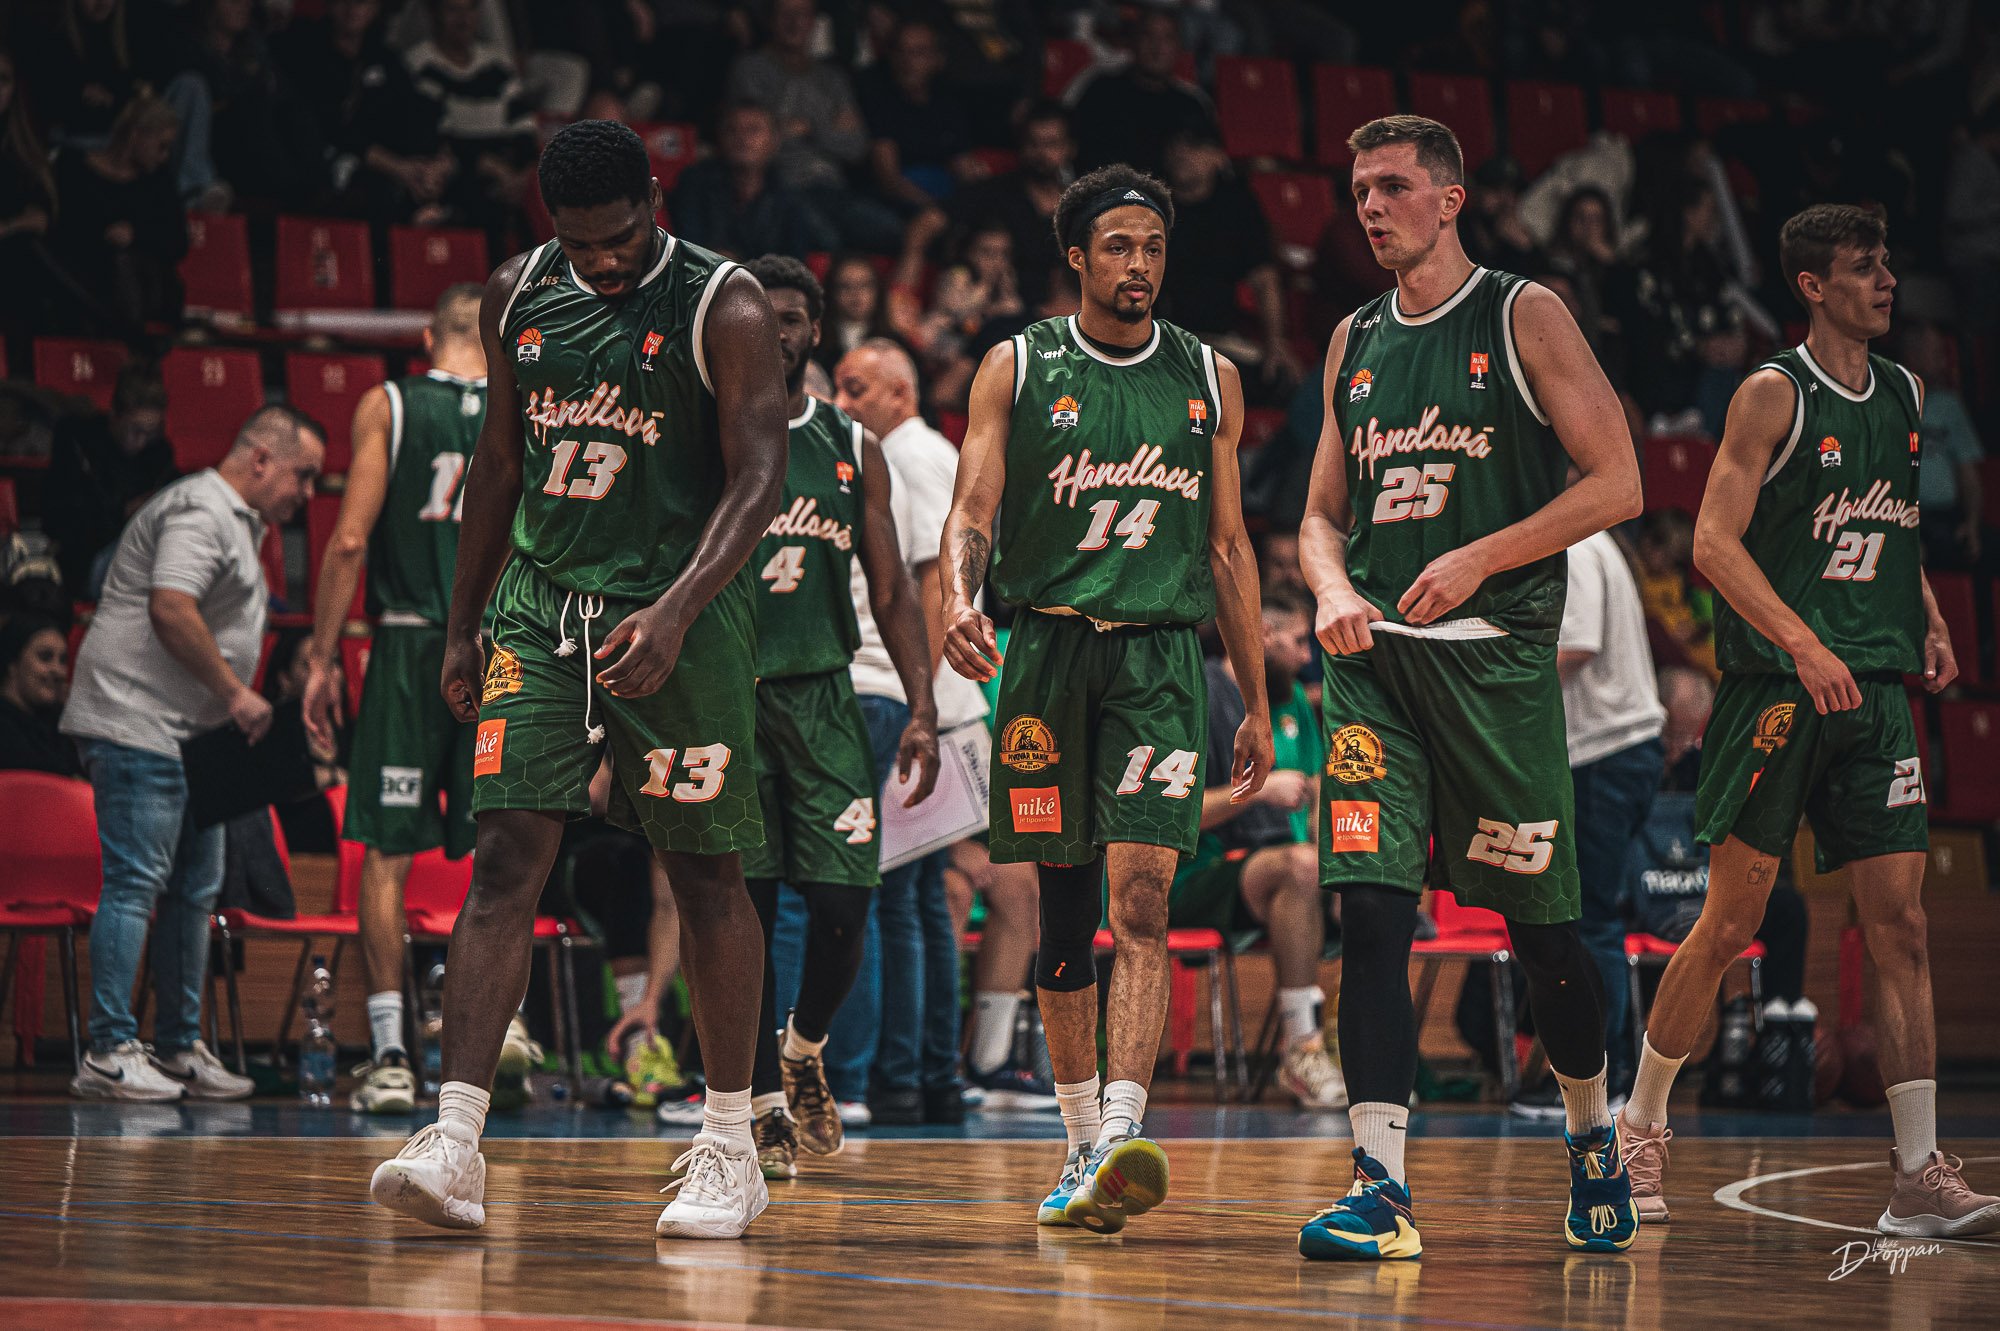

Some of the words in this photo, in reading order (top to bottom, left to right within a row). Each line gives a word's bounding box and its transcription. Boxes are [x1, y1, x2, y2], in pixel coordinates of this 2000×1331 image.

[418, 452, 463, 522] 1
[543, 440, 628, 501] 13
[1048, 443, 1204, 509] Handlová
[1372, 463, 1457, 525] 25
[762, 496, 853, 551] dlová
[1076, 498, 1162, 551] 14
[760, 545, 807, 594] 4
[1821, 531, 1886, 582] 21
[639, 742, 732, 803] 13
[1115, 745, 1199, 799] 14
[1886, 756, 1927, 809] 2
[833, 797, 877, 845] 4
[1018, 796, 1055, 816] niké
[1336, 810, 1373, 833] niké
[1466, 816, 1559, 875] 25
